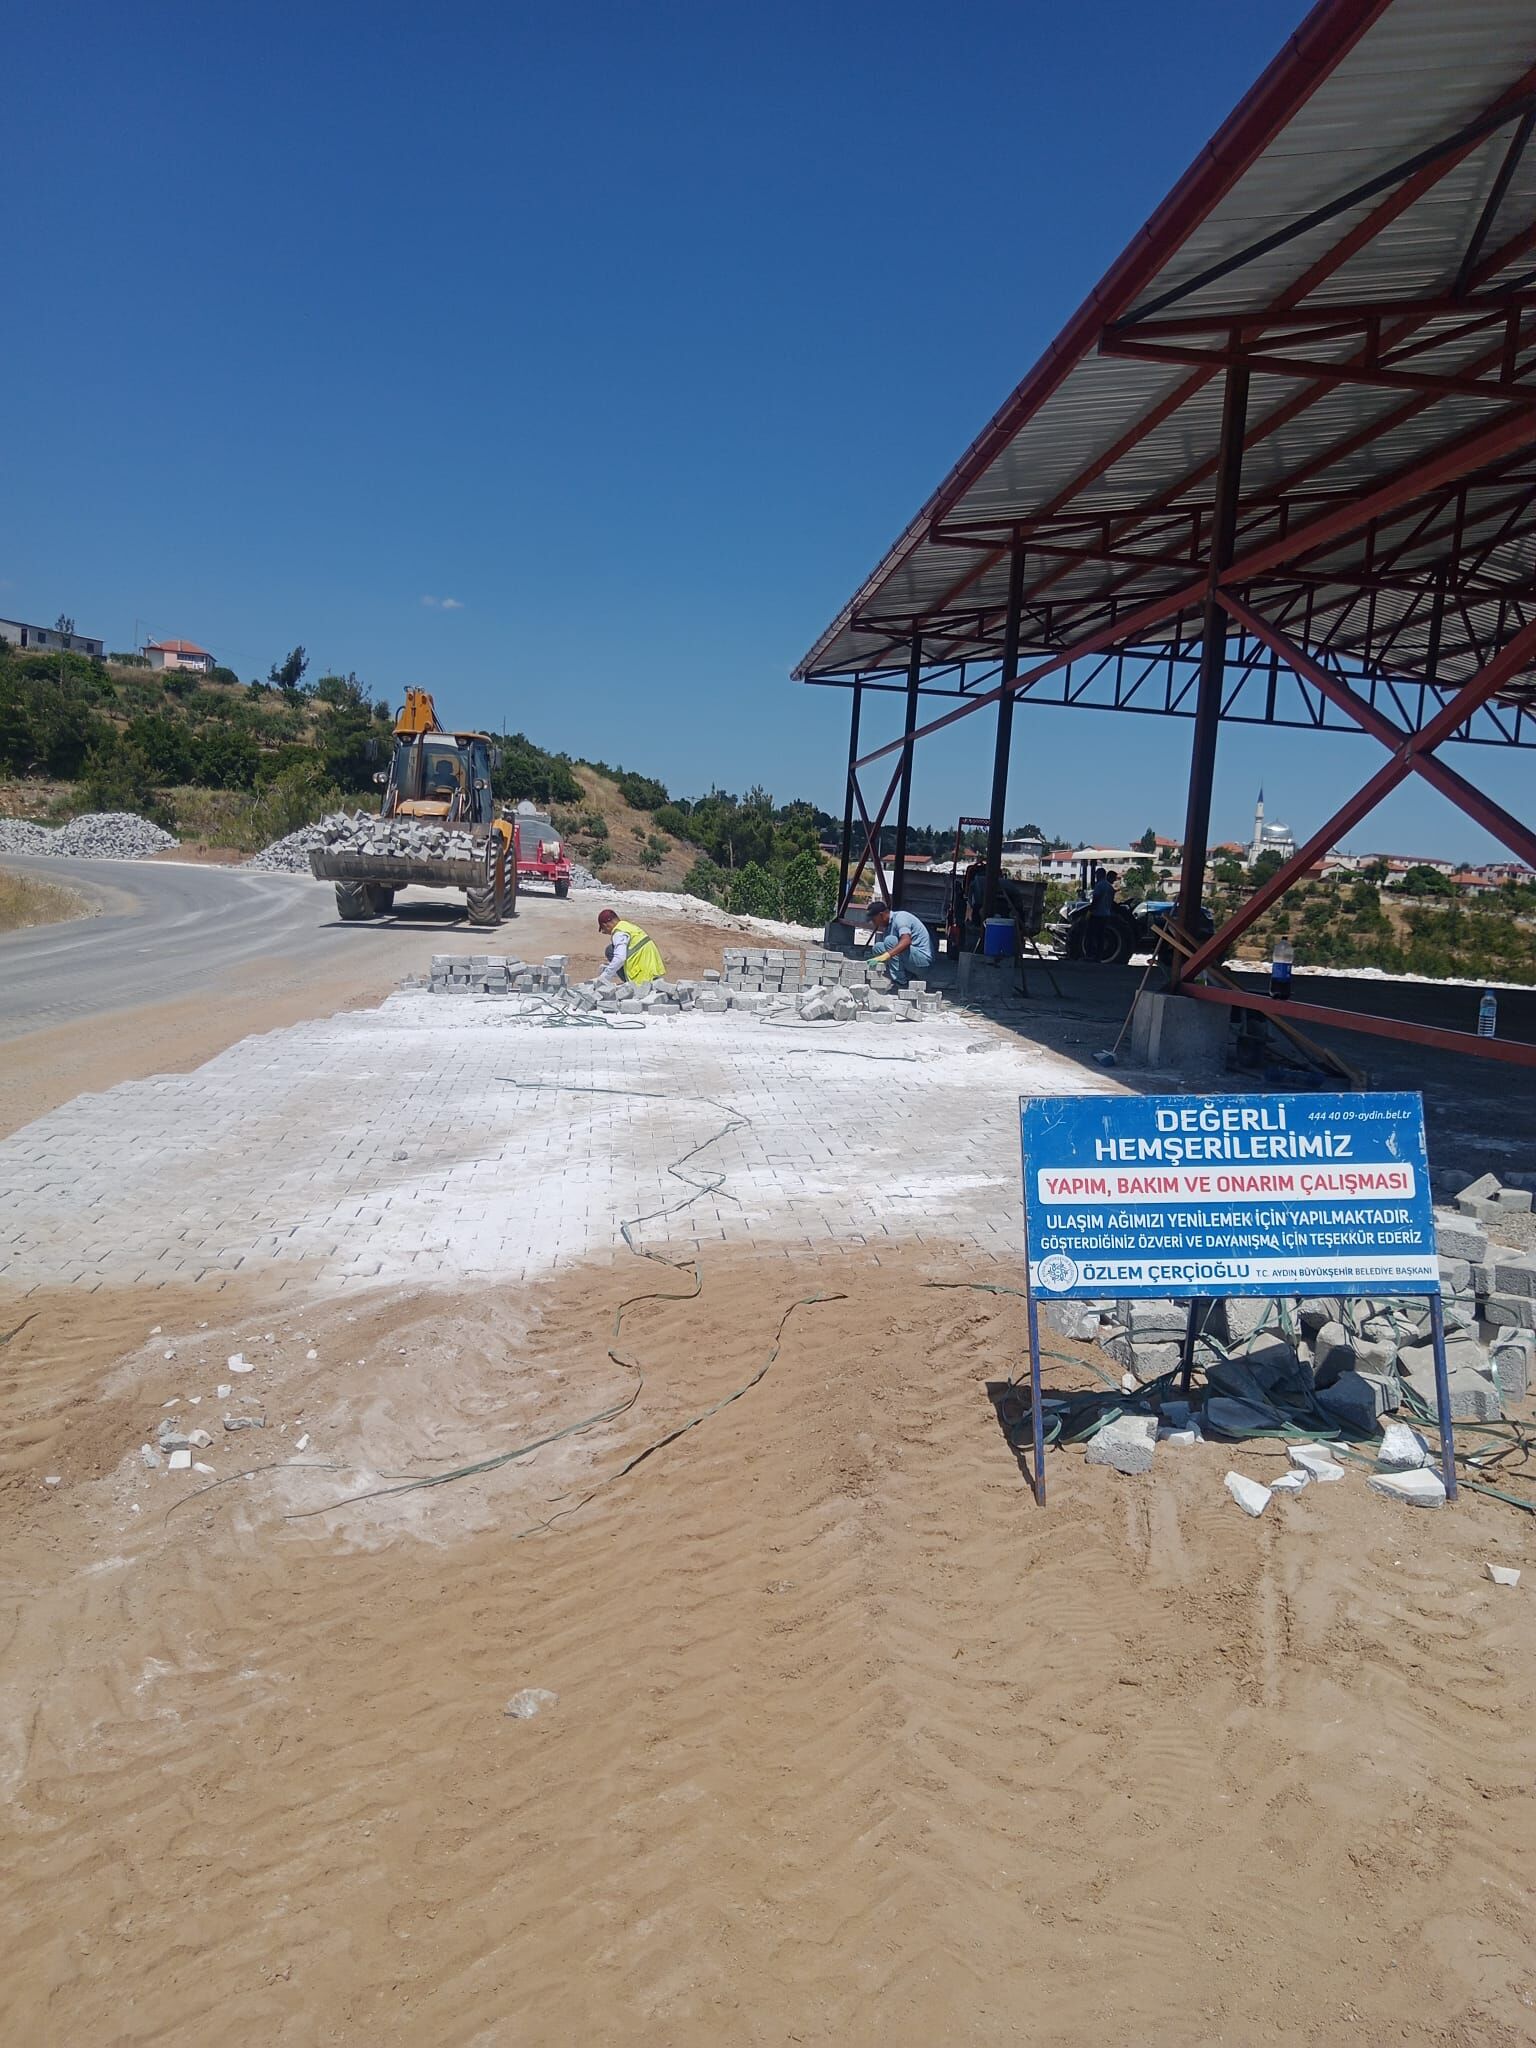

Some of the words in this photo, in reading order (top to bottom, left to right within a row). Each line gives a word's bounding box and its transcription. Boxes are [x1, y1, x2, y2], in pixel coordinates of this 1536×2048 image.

[1156, 1103, 1286, 1132] DEĞERLİ
[1308, 1112, 1326, 1121] 444
[1328, 1111, 1341, 1121] 40
[1095, 1130, 1353, 1166] HEMŞERİLERİMİZ
[1046, 1178, 1112, 1196] YAPIM,
[1117, 1177, 1179, 1194] BAKIM
[1184, 1176, 1211, 1193] VE
[1216, 1175, 1294, 1193] ONARIM
[1300, 1173, 1408, 1195] ÇALIŞMASI
[1046, 1214, 1104, 1233] ULAŞIM
[1107, 1210, 1164, 1229] AĞIMIZI
[1166, 1210, 1253, 1229] YENİLEMEK
[1255, 1209, 1287, 1230] İÇİN
[1288, 1209, 1413, 1226] YAPILMAKTADIR.
[1041, 1234, 1135, 1250] GÖSTERDİĞİNİZ
[1138, 1233, 1183, 1249] ÖZVERİ
[1185, 1235, 1202, 1248] VE
[1205, 1234, 1280, 1250] DAYANIŞMA
[1281, 1231, 1308, 1250] İÇİN
[1310, 1230, 1375, 1249] TEŞEKKÜR
[1377, 1229, 1422, 1244] EDERİZ
[1083, 1264, 1143, 1281] ÖZLEM
[1148, 1261, 1250, 1283] ÇERÇİOĞLU
[1272, 1269, 1297, 1277] AYDIN
[1299, 1266, 1354, 1278] BÜYÜKŞEHİR
[1355, 1267, 1394, 1276] BELEDİYE
[1396, 1267, 1432, 1277] BAŞKANI
